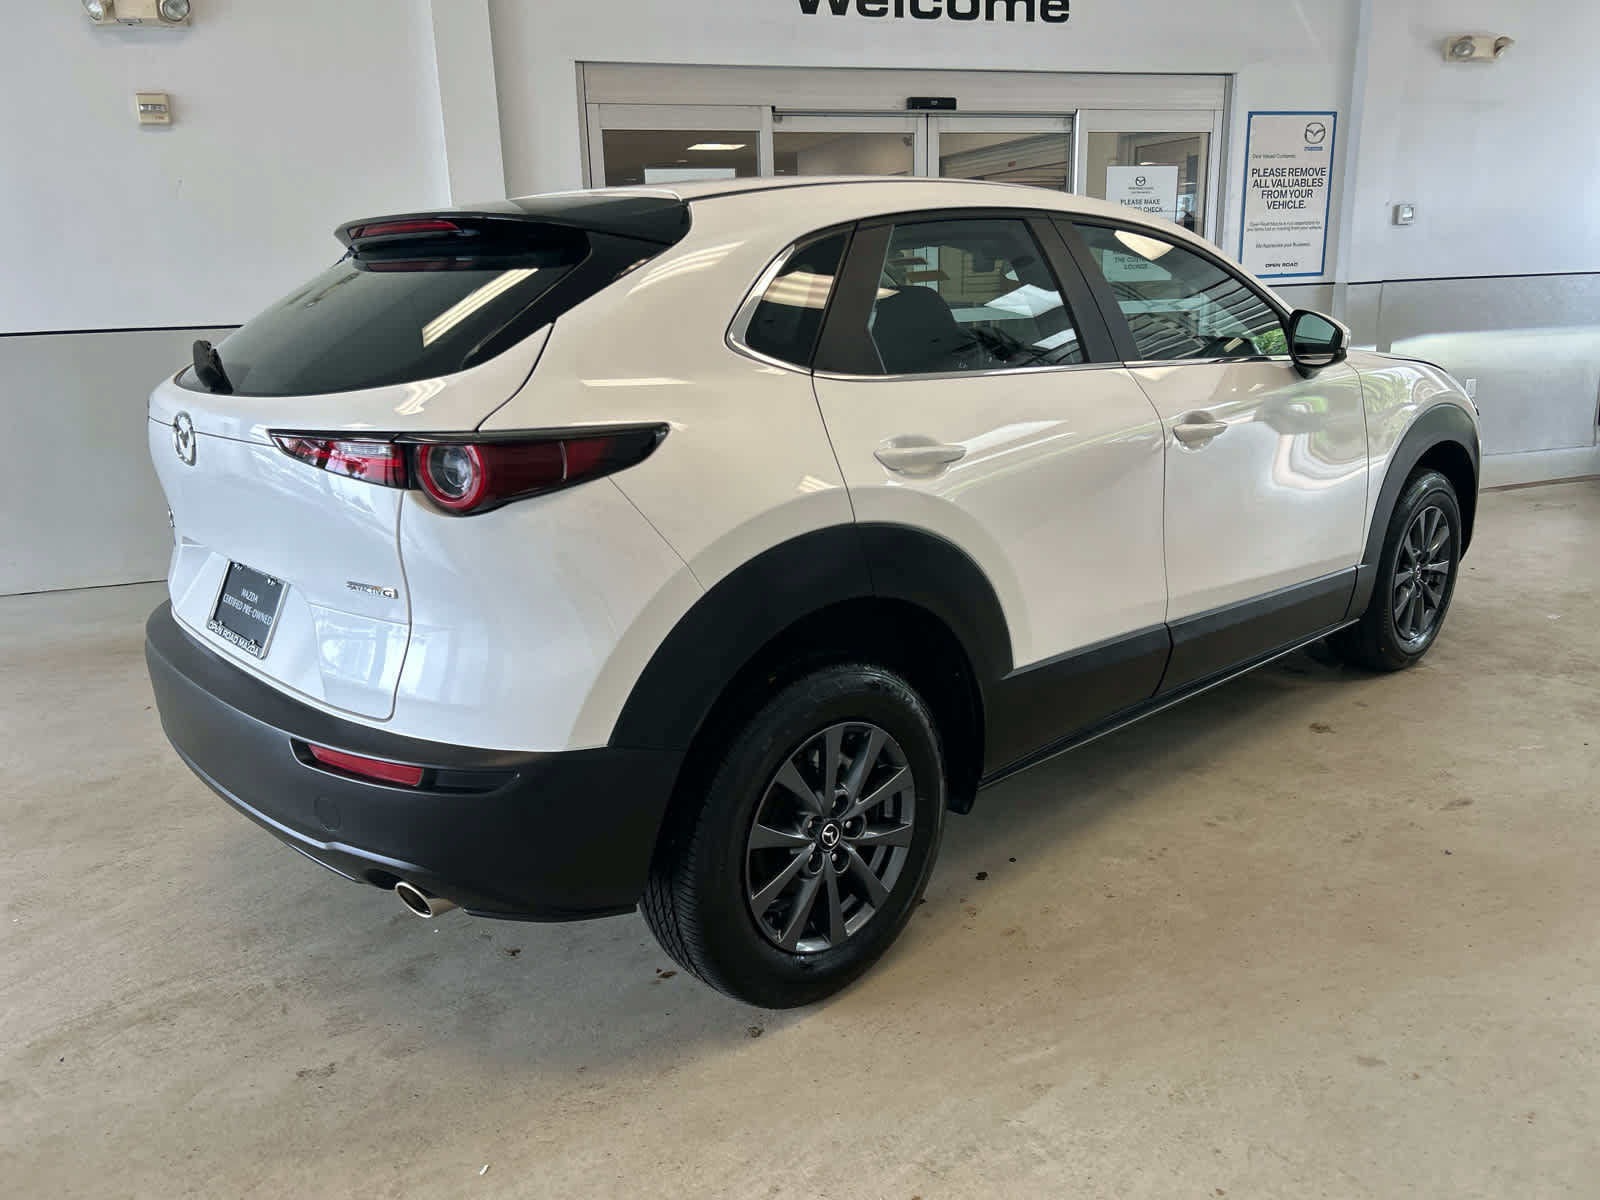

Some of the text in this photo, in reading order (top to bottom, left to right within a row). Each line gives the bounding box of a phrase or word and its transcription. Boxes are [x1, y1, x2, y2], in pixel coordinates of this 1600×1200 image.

[1252, 167, 1326, 178] PLEASE REMOVE
[1252, 178, 1324, 188] ALL VALUABLES
[1261, 189, 1313, 199] FROM YOUR
[1266, 200, 1306, 209] VEHICLE.
